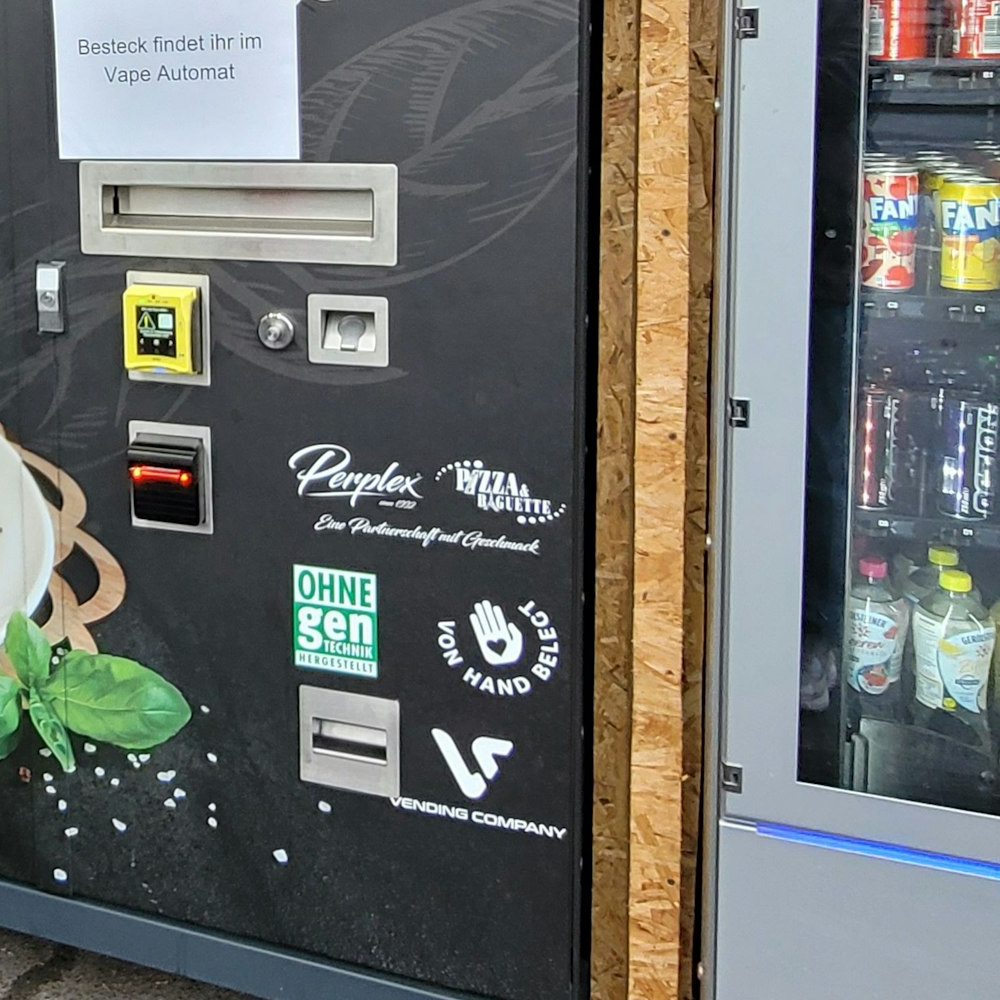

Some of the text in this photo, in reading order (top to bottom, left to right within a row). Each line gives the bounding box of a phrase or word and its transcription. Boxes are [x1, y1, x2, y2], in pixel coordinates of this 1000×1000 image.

[78, 32, 262, 55] Besteck findet ihr im
[104, 63, 235, 86] Vape Automat
[288, 443, 423, 508] Perplex
[455, 467, 519, 497] PIZZA
[477, 491, 552, 515] BAGUETTE
[313, 514, 540, 555] Eine Partnerschaft mit Geschmack
[298, 569, 372, 608] OHNE
[298, 606, 373, 651] gen
[299, 653, 373, 673] HERGESTELLT
[323, 639, 374, 660] TECHNIK
[437, 600, 559, 696] VON HAND BELEGT
[389, 796, 568, 839] VENDING COMPANY
